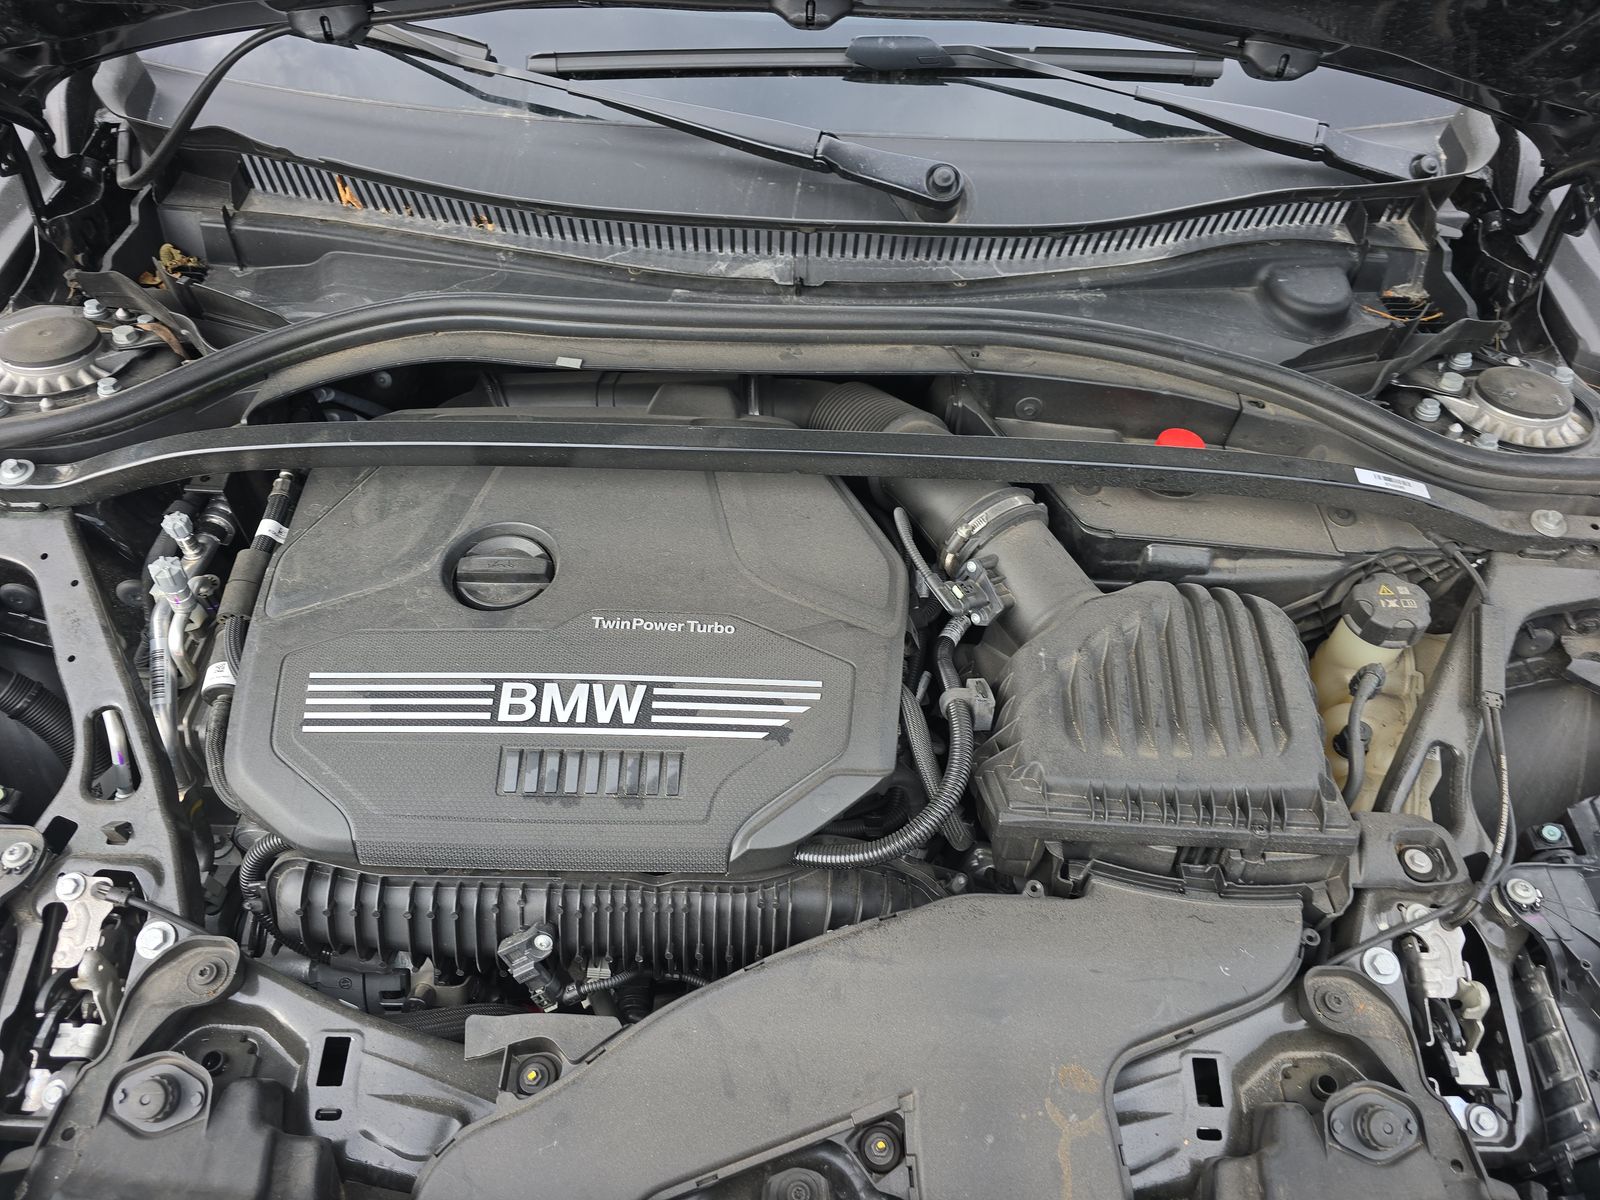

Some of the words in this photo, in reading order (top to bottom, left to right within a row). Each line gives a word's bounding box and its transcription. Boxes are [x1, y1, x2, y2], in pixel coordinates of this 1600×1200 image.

[592, 616, 685, 632] TwinPower
[687, 620, 736, 634] Turbo
[497, 682, 648, 724] BMW
